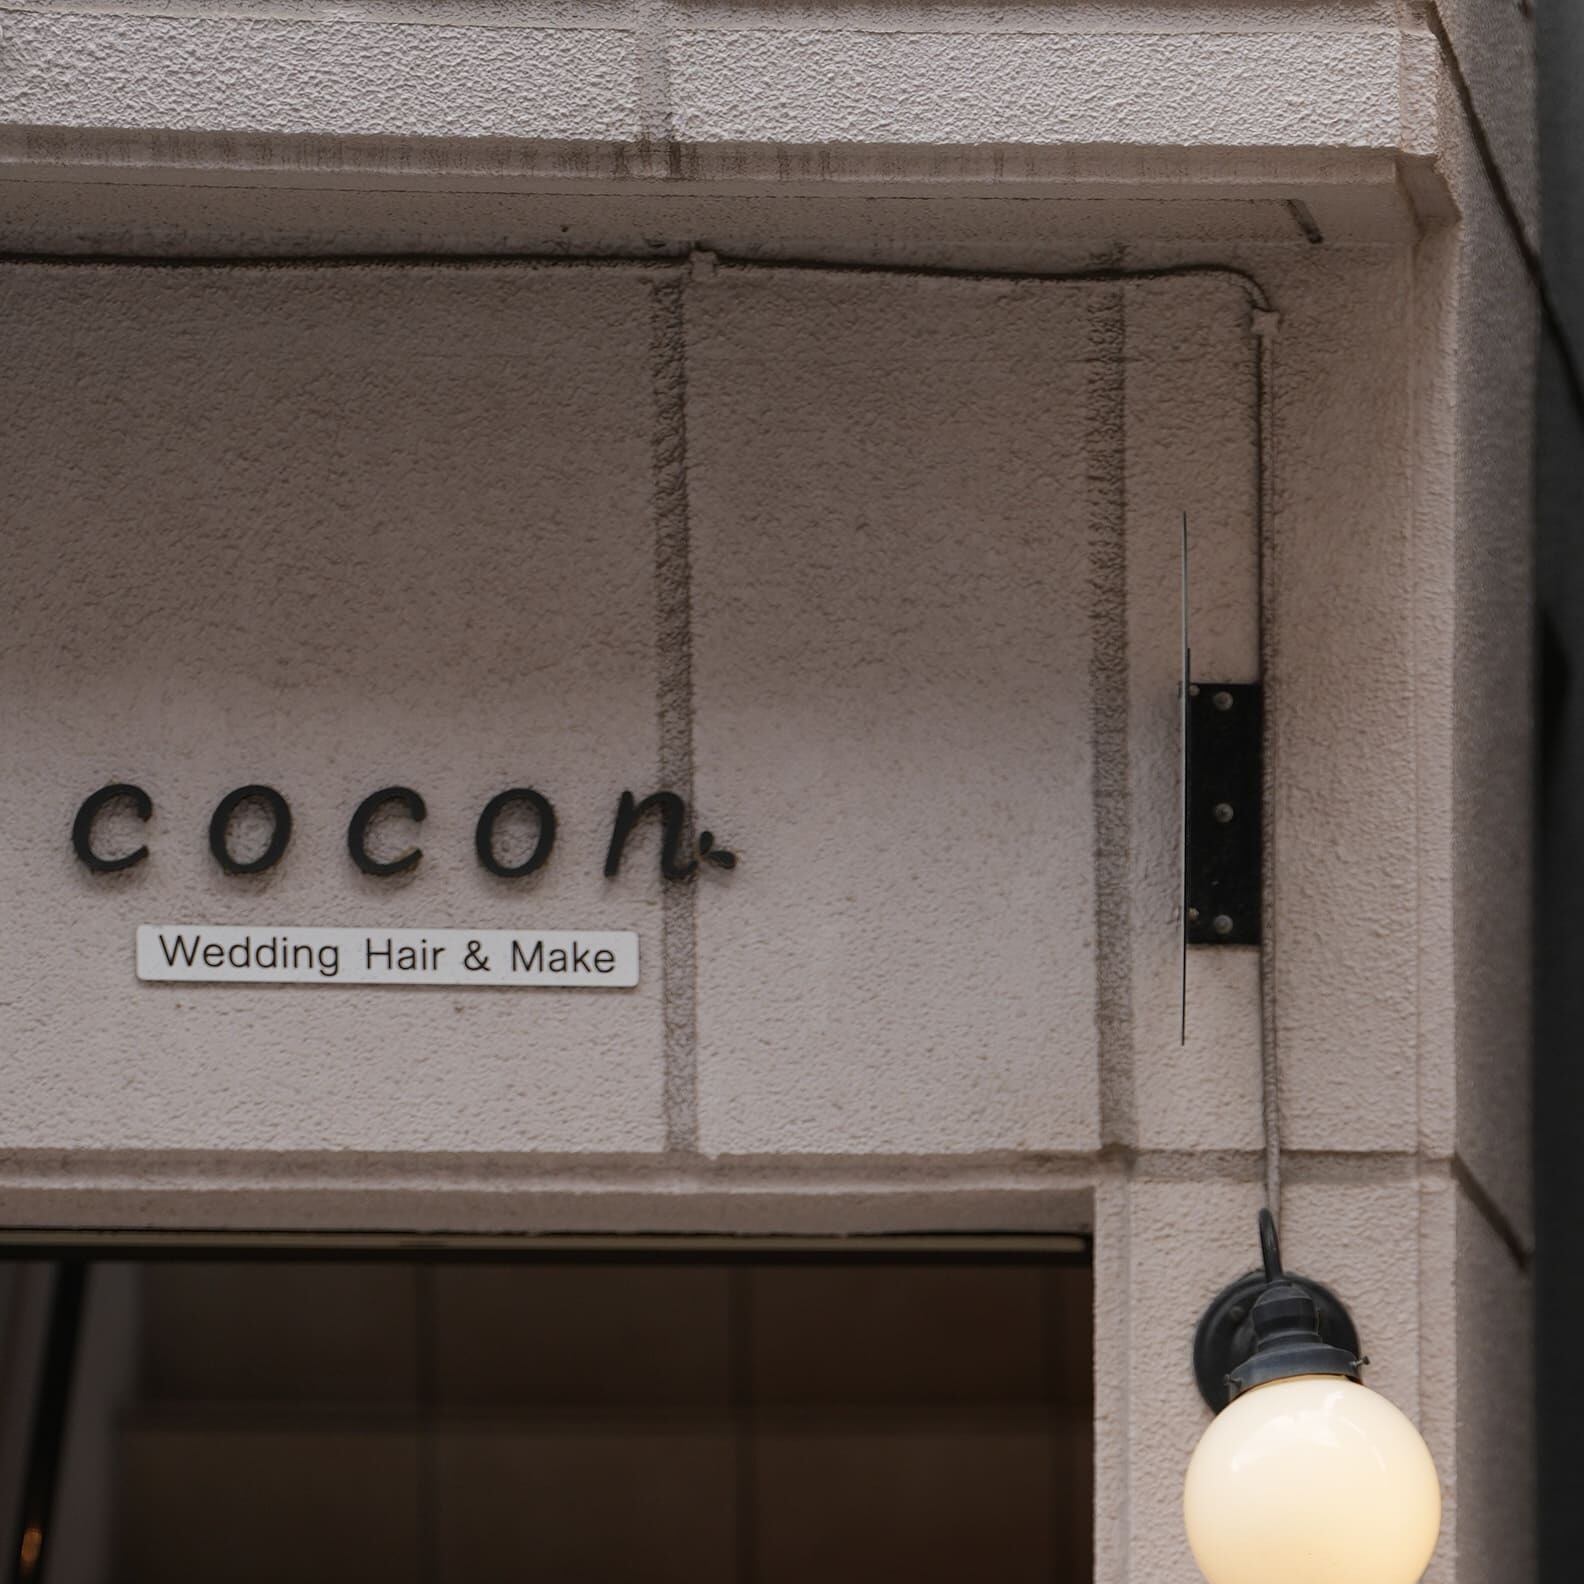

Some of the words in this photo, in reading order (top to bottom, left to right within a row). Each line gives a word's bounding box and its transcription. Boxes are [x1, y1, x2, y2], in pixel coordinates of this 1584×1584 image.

[71, 783, 699, 881] cocon
[158, 933, 340, 977] Wedding
[366, 936, 445, 971] Hair
[463, 940, 491, 972] &
[511, 939, 617, 974] Make
